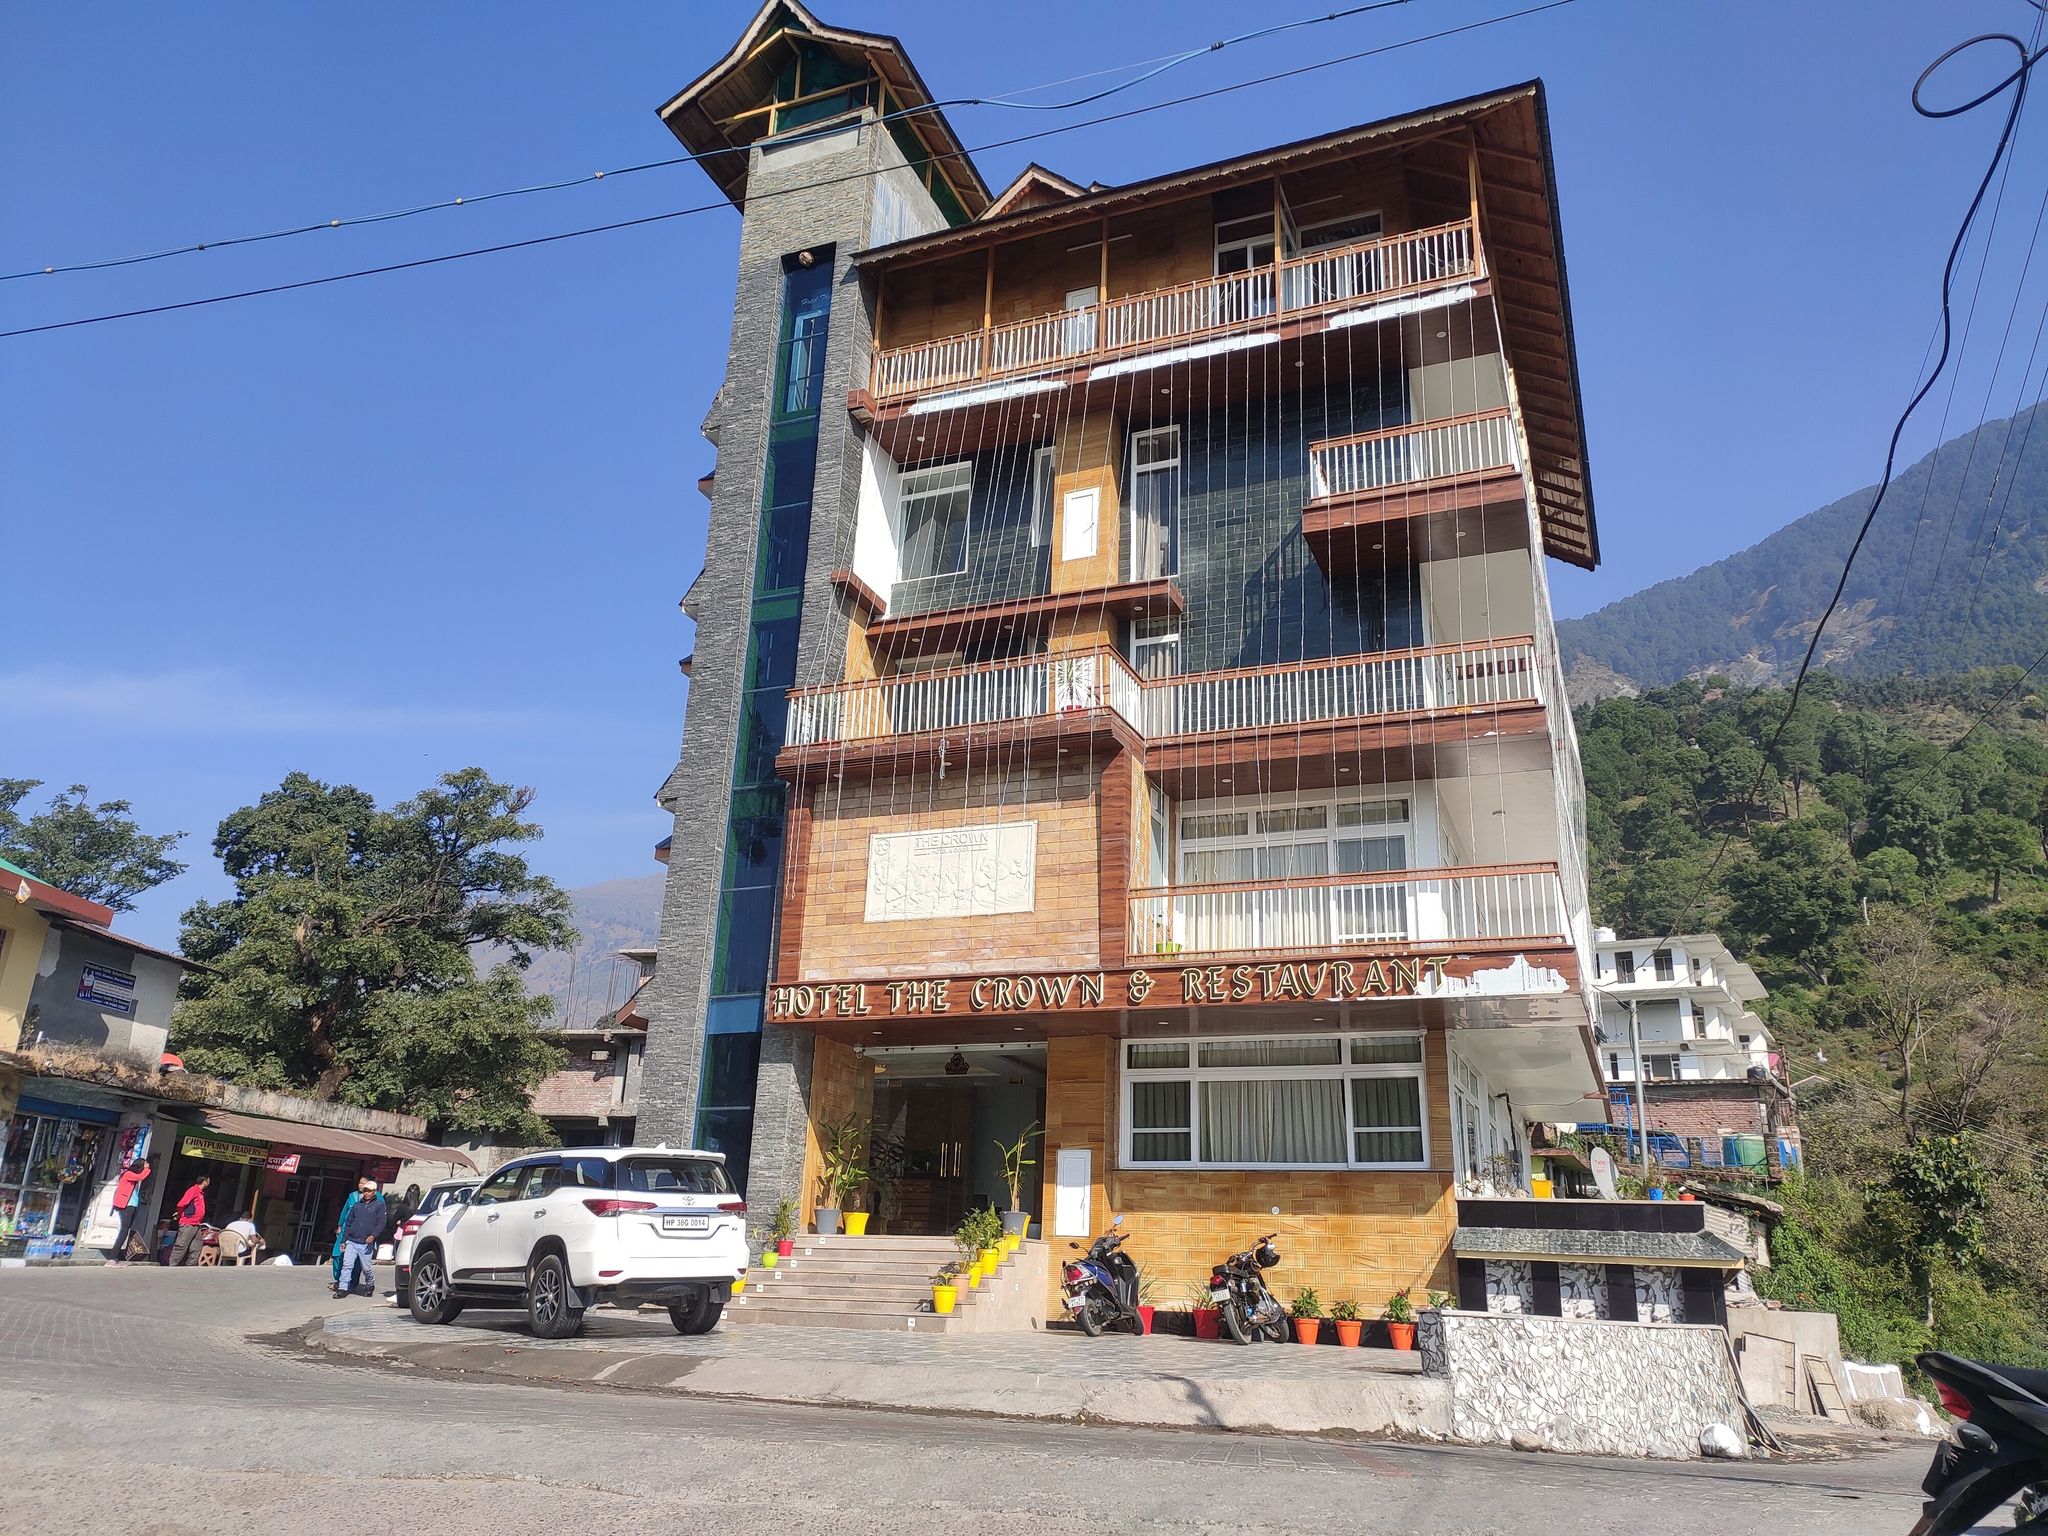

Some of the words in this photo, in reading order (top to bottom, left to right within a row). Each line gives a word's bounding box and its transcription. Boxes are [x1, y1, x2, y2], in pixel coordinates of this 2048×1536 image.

[914, 836, 939, 848] THE
[941, 832, 988, 846] CROWN
[773, 983, 872, 1017] HOTEL
[888, 979, 951, 1013] THE
[970, 972, 1105, 1011] CROWN
[1128, 969, 1157, 1003] &
[1181, 954, 1452, 1001] RESTAURANT
[186, 1138, 229, 1150] CHINTPURNI
[231, 1145, 262, 1156] TRADERS
